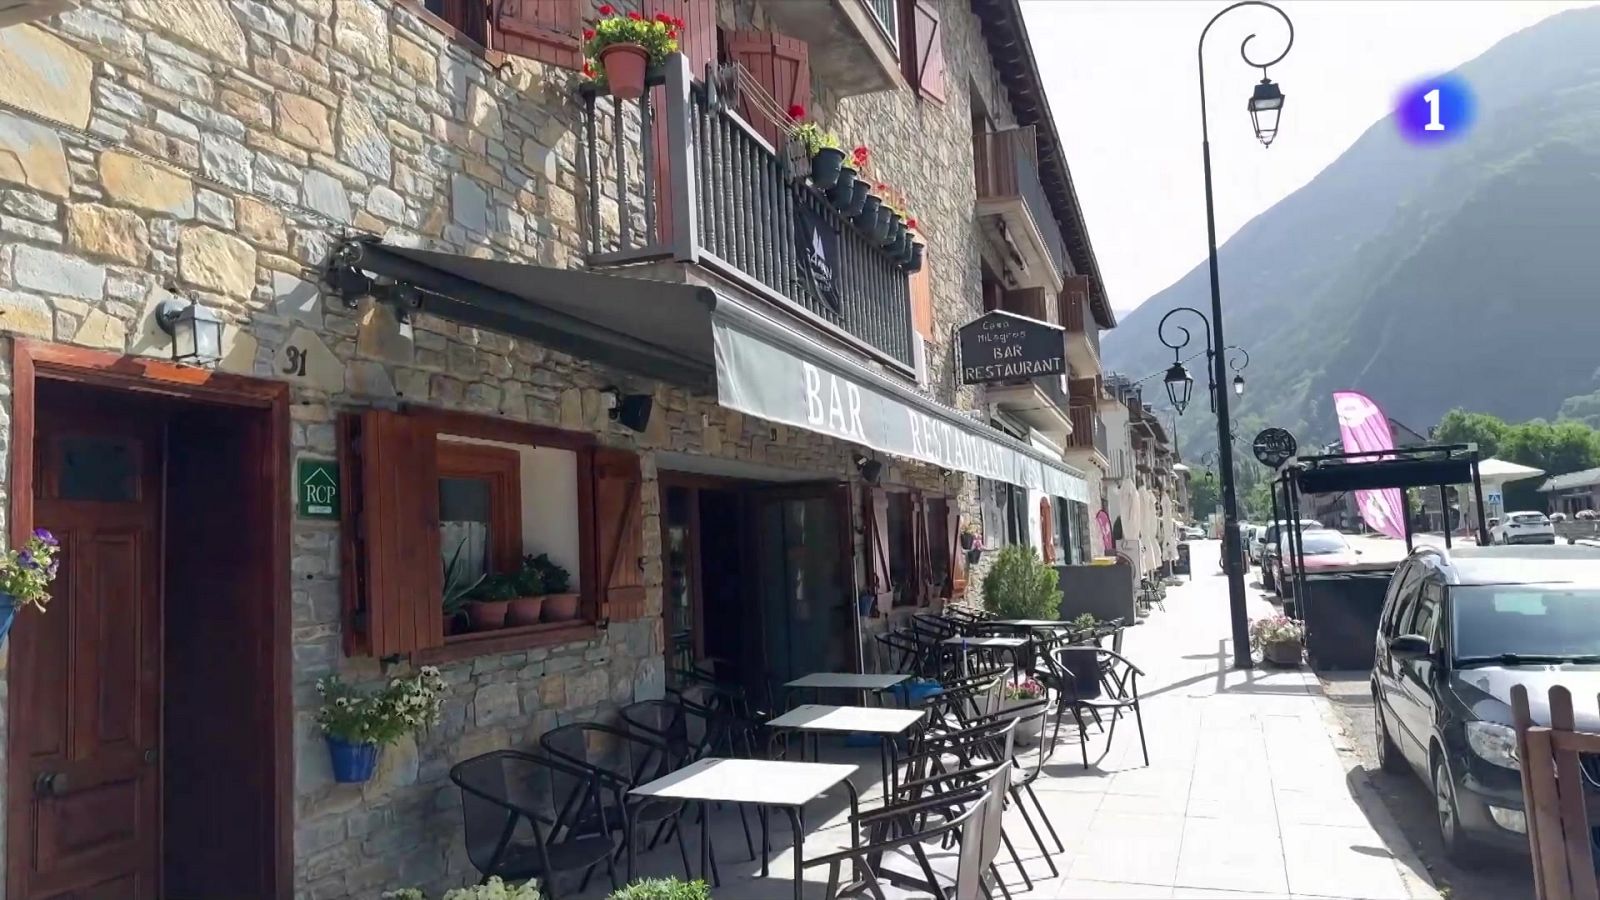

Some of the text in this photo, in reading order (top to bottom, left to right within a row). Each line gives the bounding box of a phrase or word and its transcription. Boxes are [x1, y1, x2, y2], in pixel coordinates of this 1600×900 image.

[283, 345, 307, 377] 31
[993, 344, 1023, 360] BAR
[965, 357, 1062, 380] RESTAURANT
[803, 361, 866, 441] BAR
[907, 409, 1007, 477] RESTAURANT
[306, 484, 336, 503] RCP
